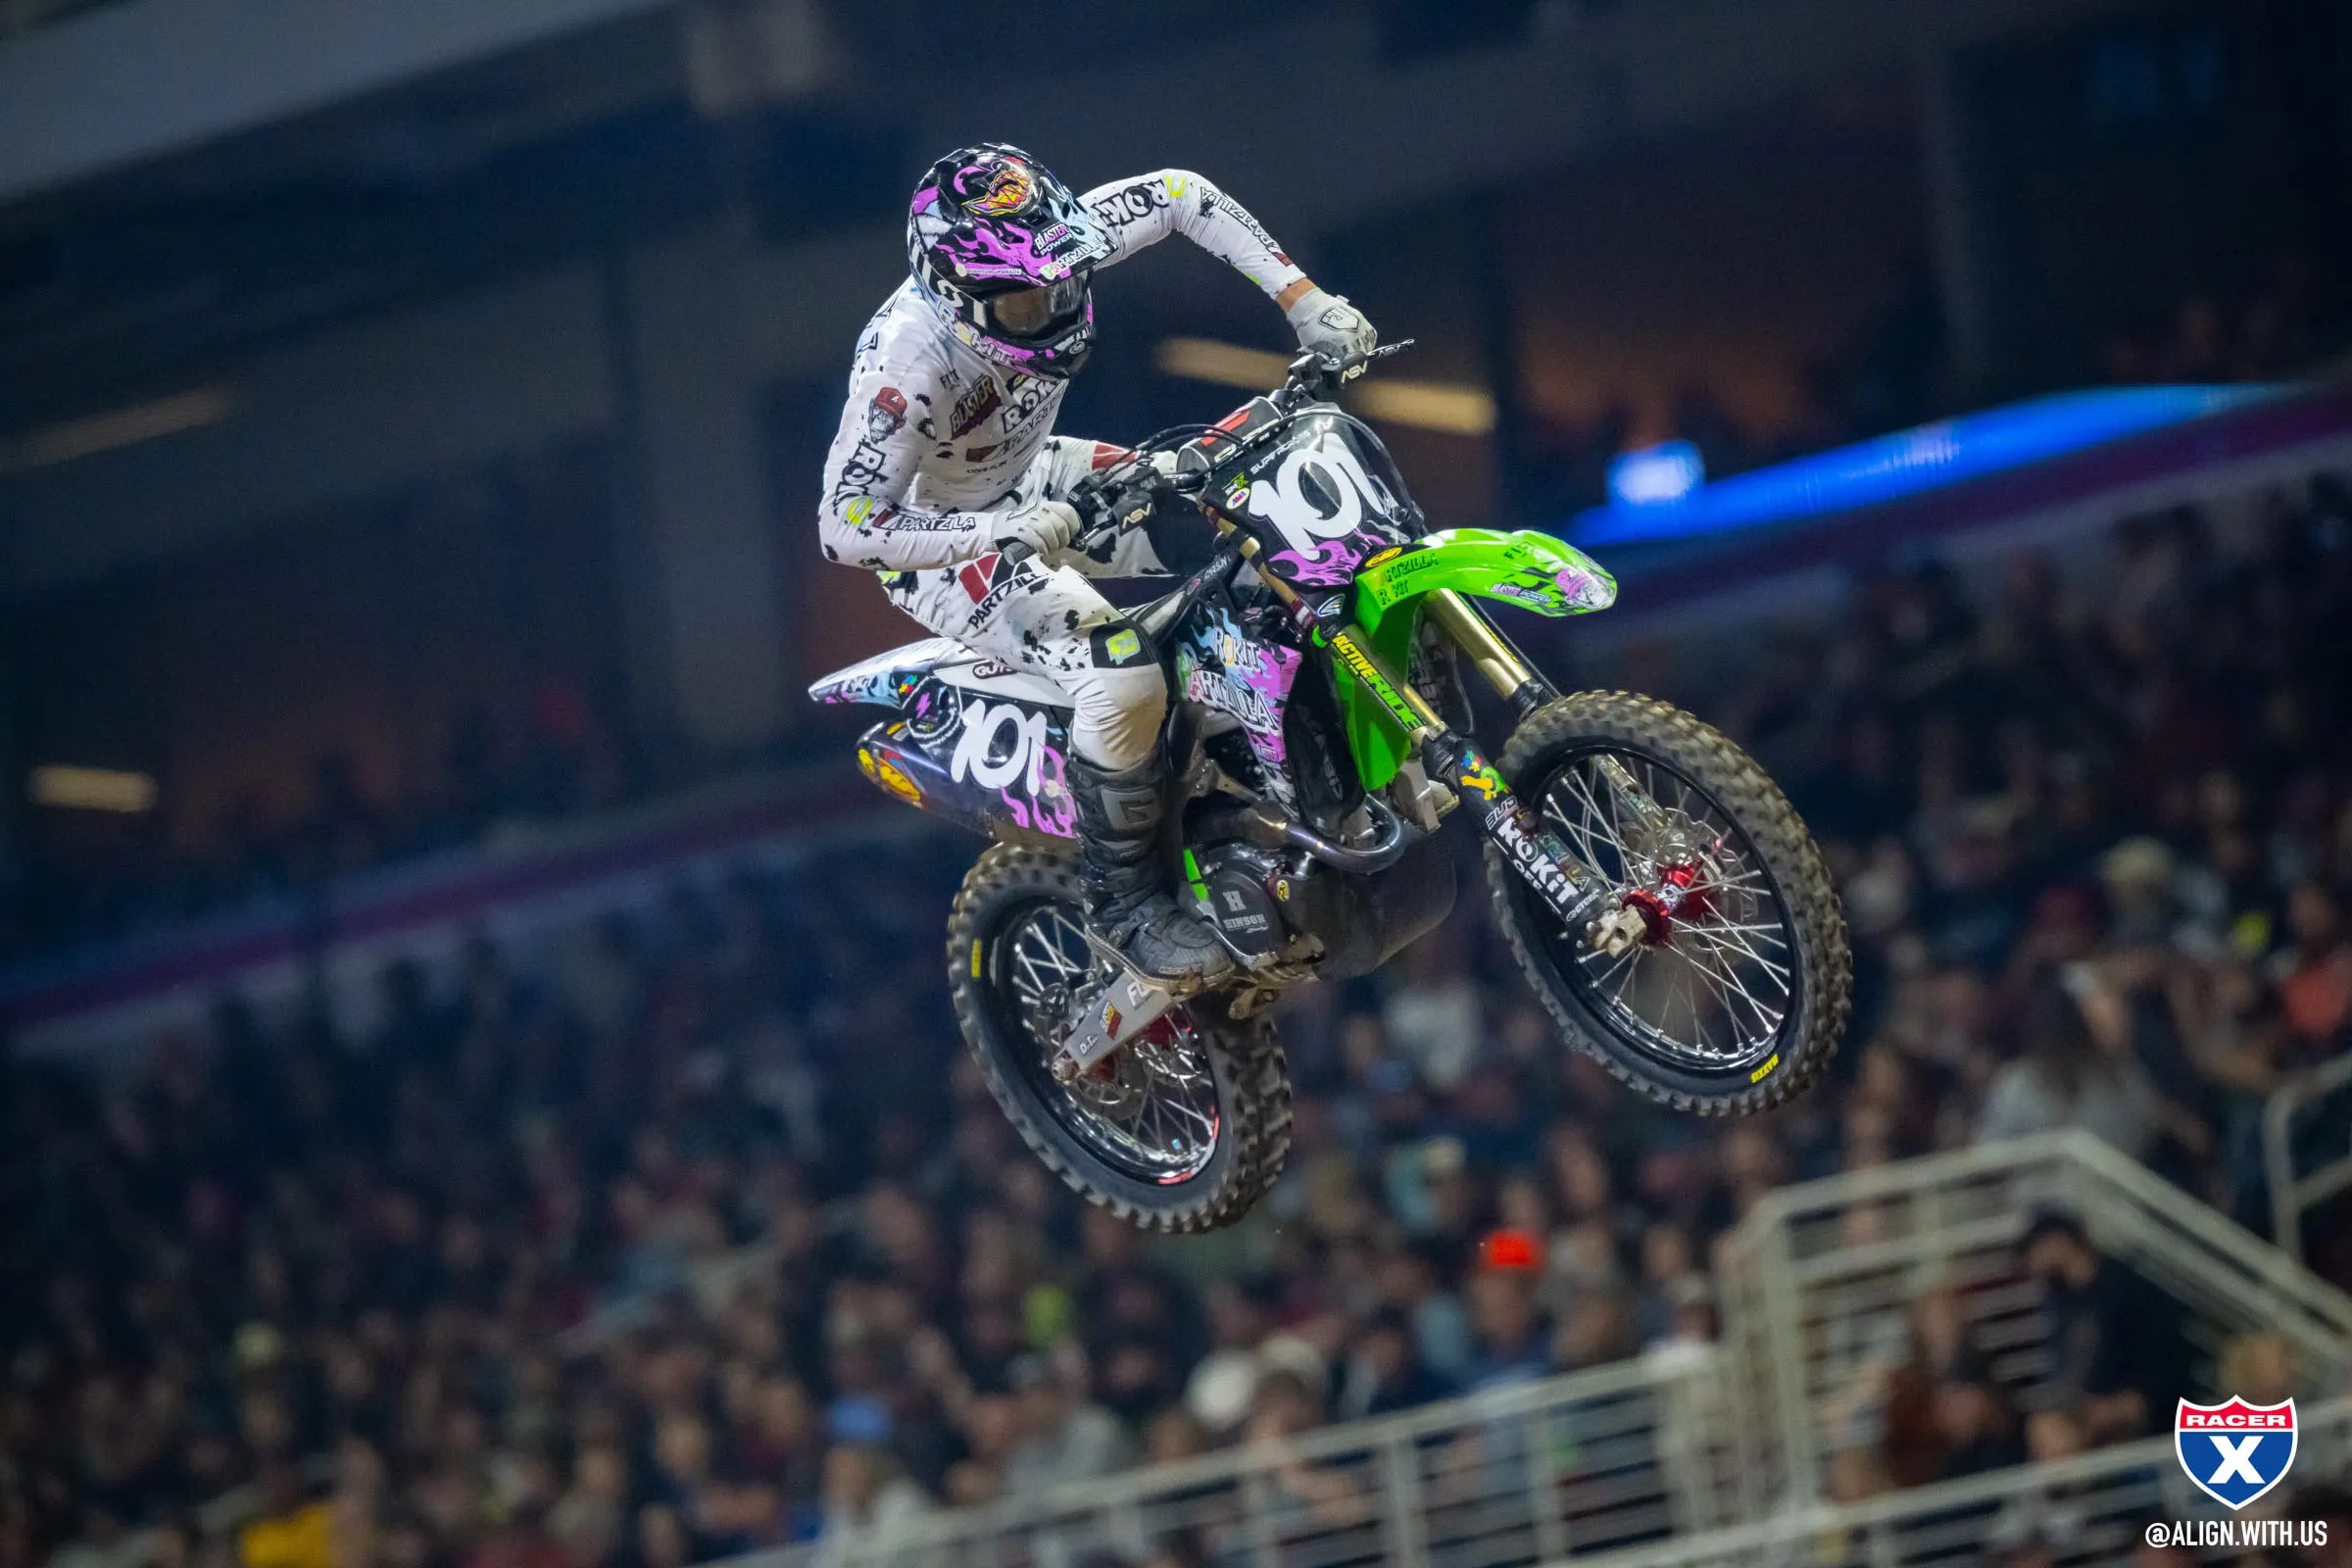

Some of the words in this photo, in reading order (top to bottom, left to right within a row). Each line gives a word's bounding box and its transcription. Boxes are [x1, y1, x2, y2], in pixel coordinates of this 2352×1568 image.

[1035, 222, 1069, 251] BLASTER
[1040, 232, 1073, 256] POWER
[1250, 429, 1311, 475] SUPERCROSS
[950, 699, 1047, 797] 101
